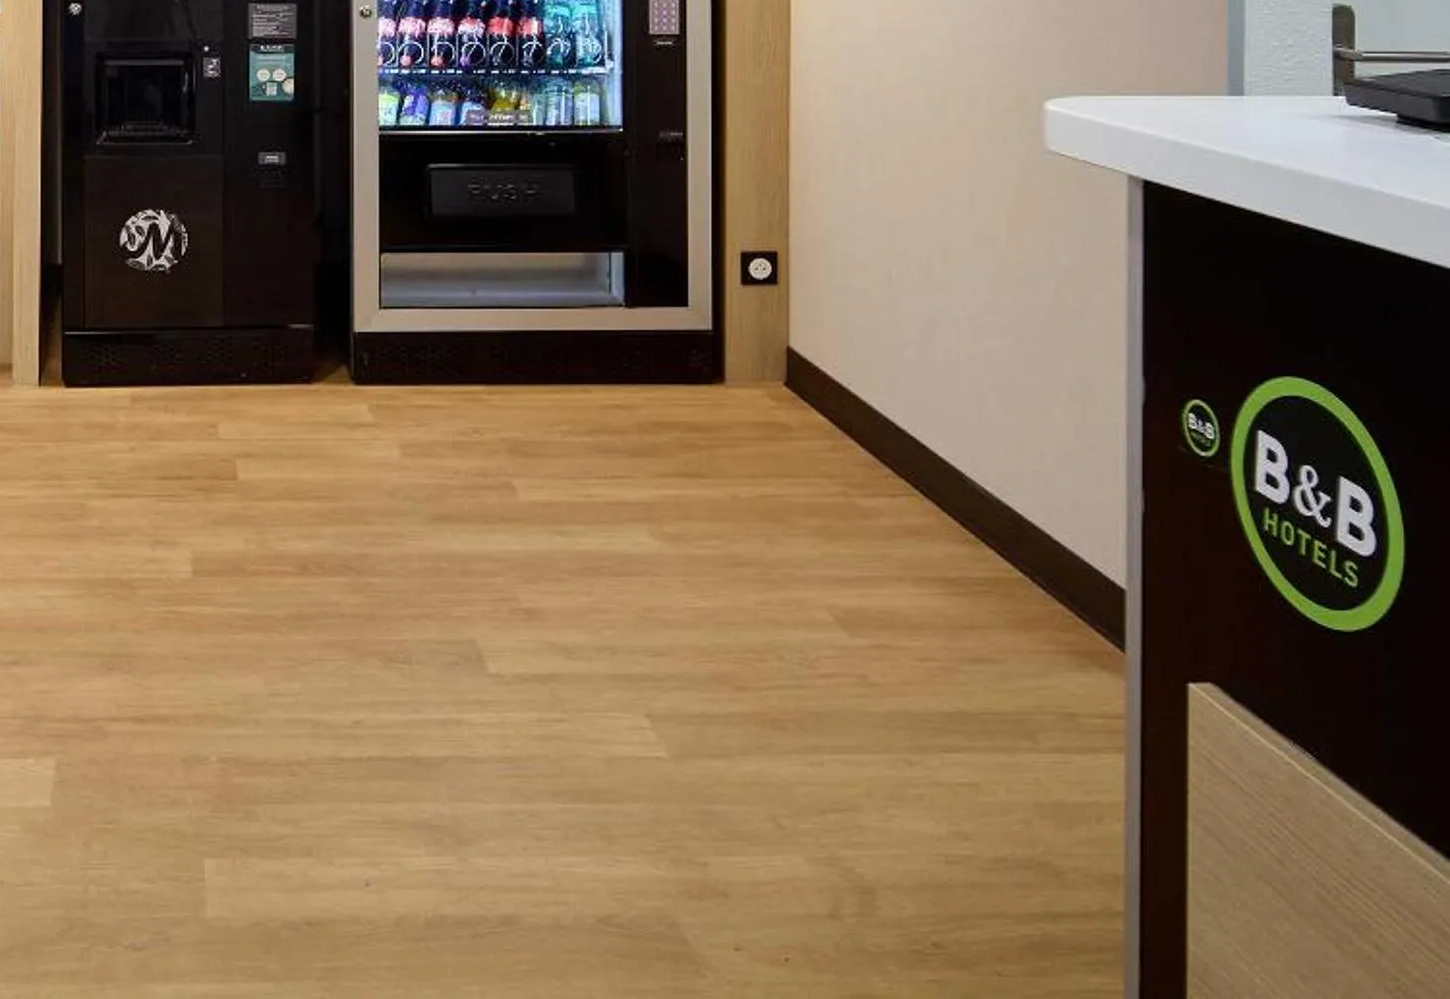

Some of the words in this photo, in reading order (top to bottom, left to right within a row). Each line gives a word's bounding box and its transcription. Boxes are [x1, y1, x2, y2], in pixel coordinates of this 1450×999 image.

[1188, 412, 1215, 440] B&B
[1254, 429, 1377, 557] B&B
[1262, 507, 1359, 588] HOTELS
